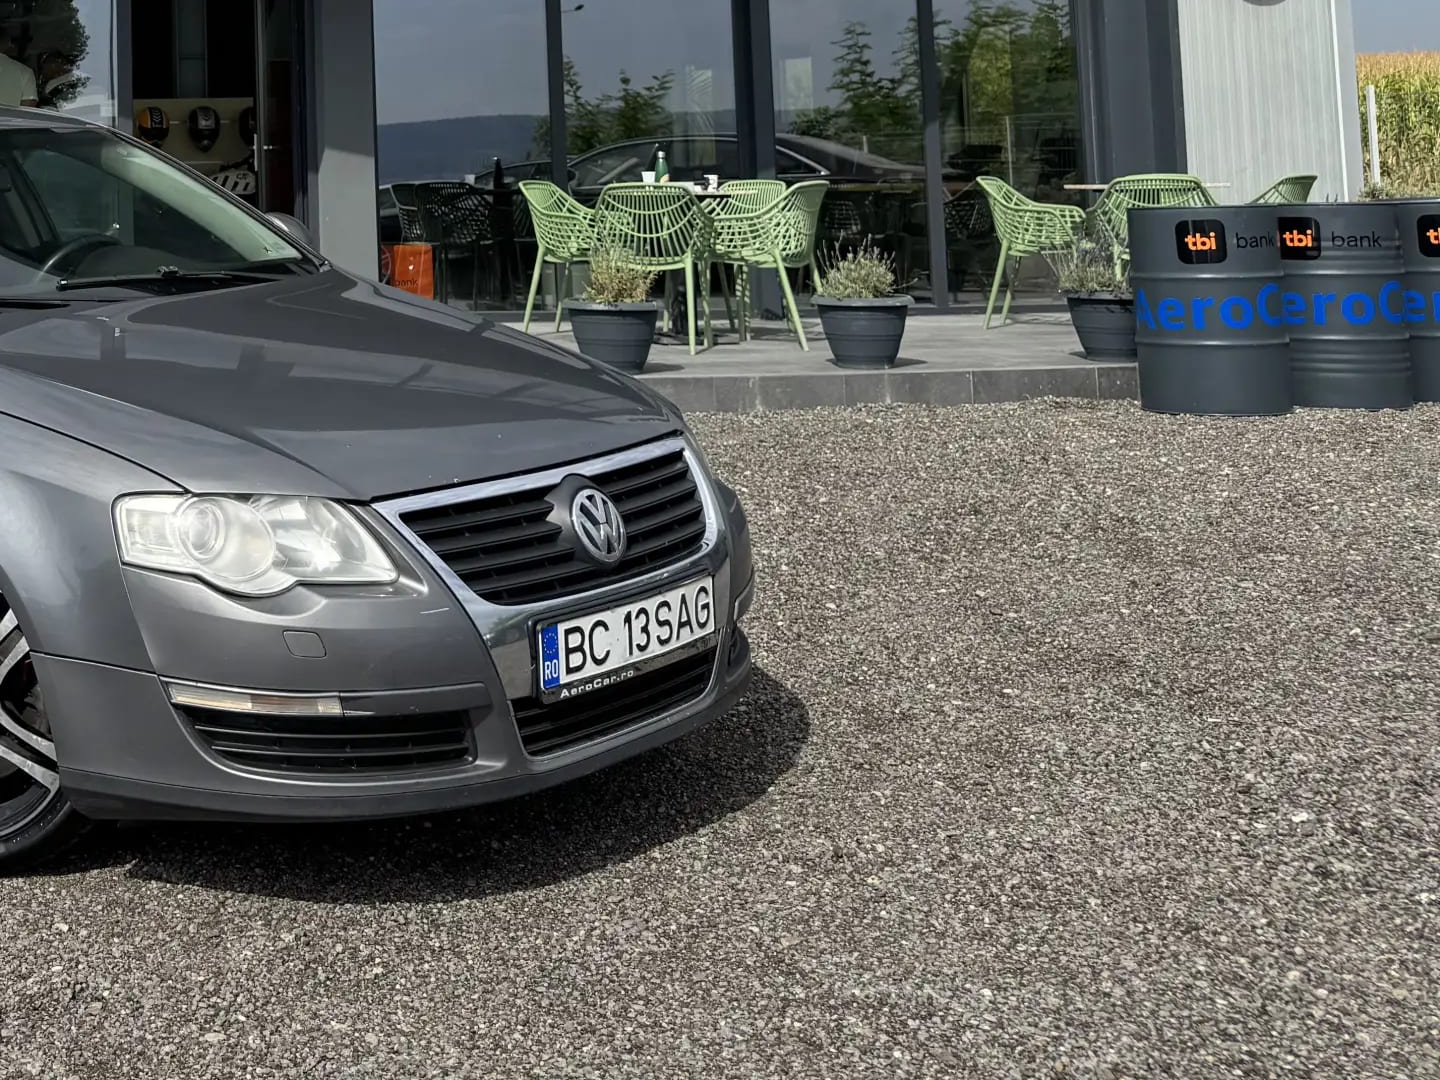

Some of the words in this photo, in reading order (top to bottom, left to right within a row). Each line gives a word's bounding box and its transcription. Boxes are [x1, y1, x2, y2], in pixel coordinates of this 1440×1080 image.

[1185, 232, 1217, 250] tbi
[1236, 232, 1274, 249] bank
[1283, 230, 1313, 248] tbi
[1331, 231, 1382, 248] bank
[564, 620, 611, 675] BC
[544, 659, 559, 681] RO
[560, 669, 634, 699] AeroCar.ro
